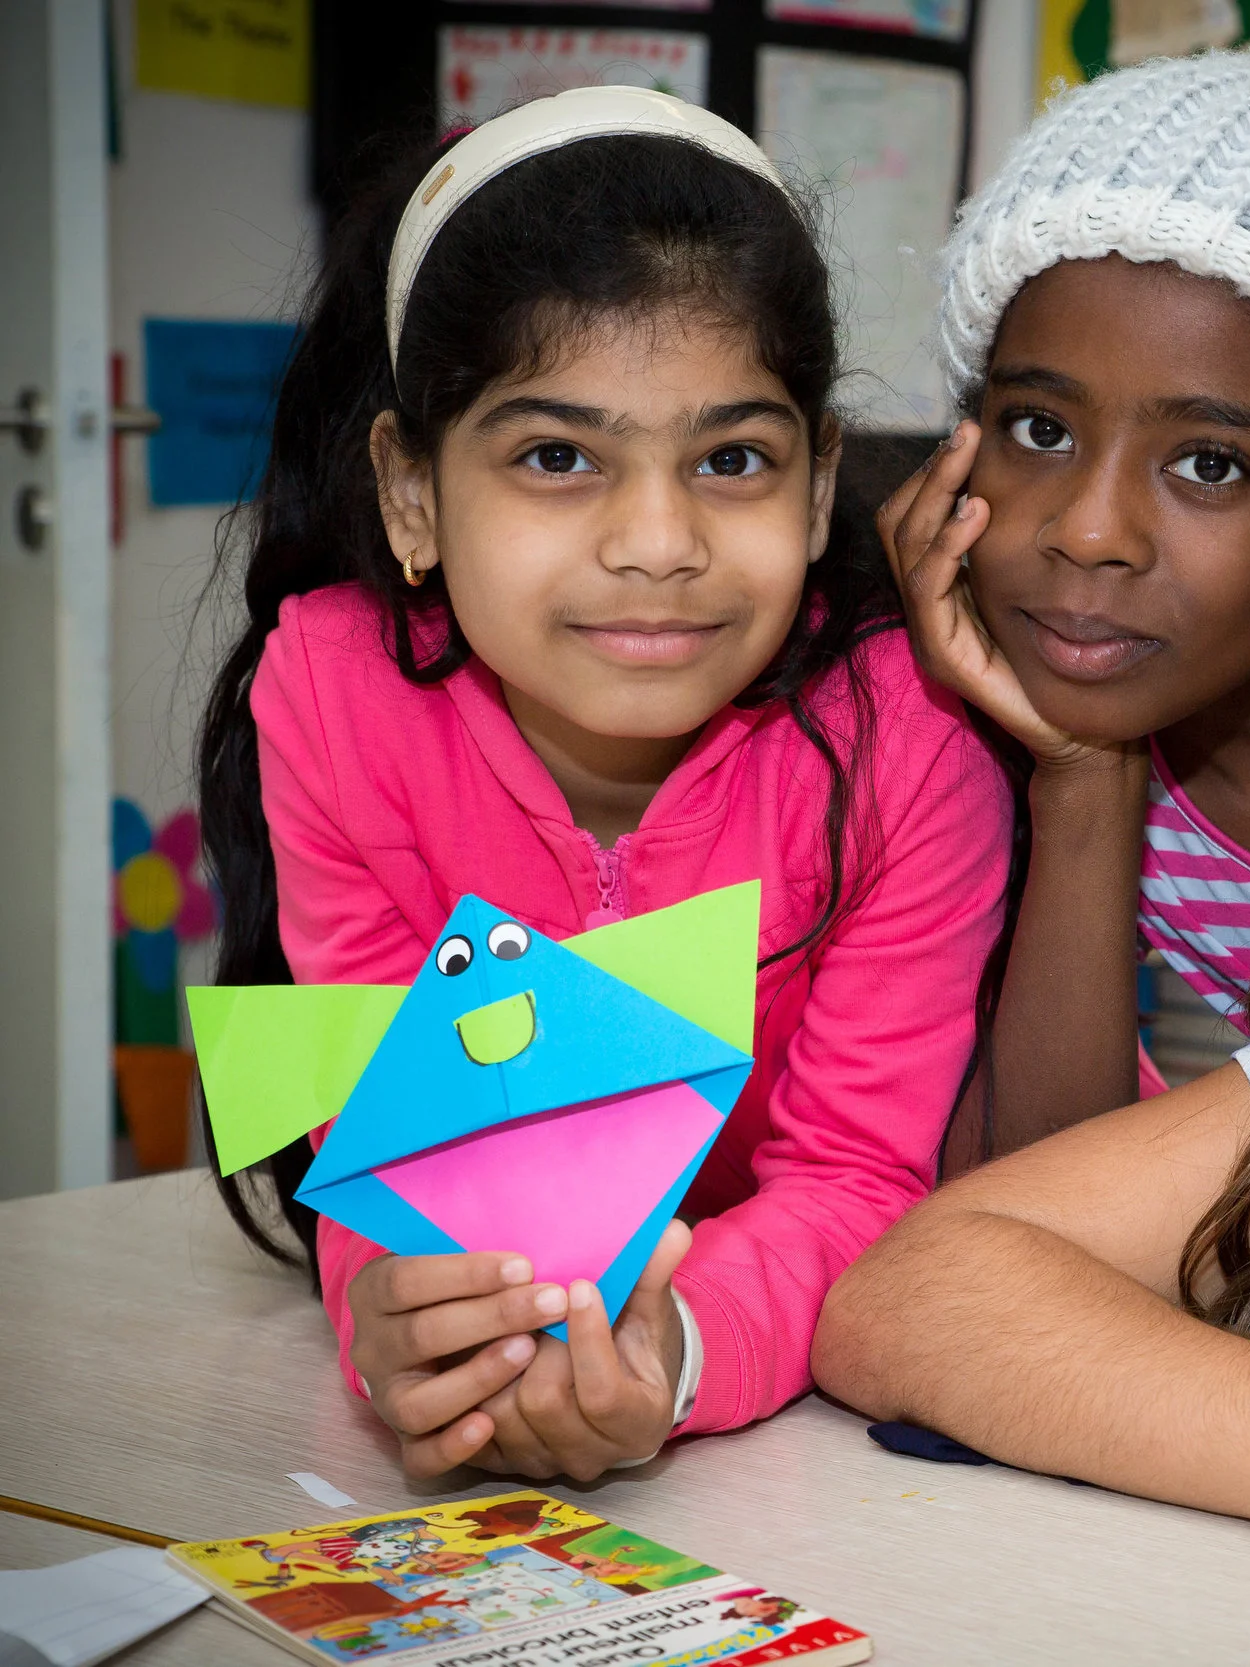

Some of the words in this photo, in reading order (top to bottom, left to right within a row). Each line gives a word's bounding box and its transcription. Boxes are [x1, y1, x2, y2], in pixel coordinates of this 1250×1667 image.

[604, 1599, 710, 1632] enfant
[541, 1615, 704, 1664] malheur!
[760, 1631, 854, 1660] VIVE
[500, 1658, 536, 1667] u
